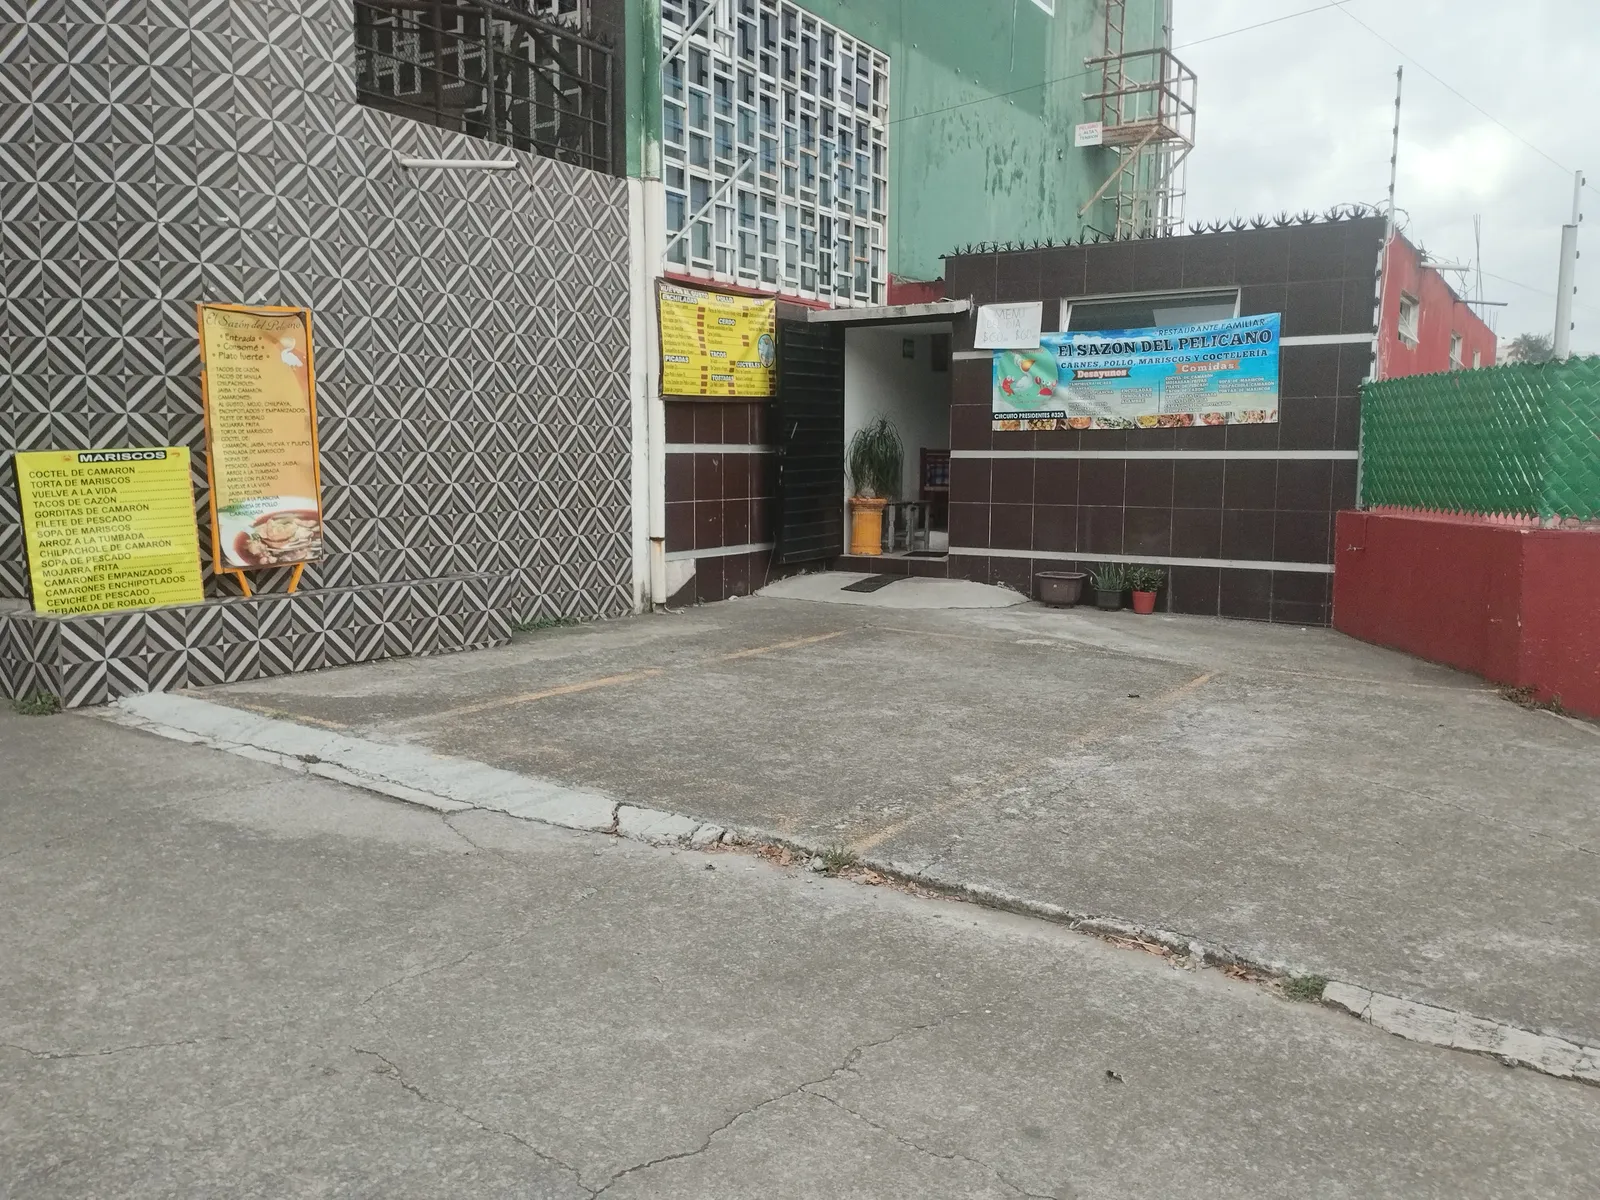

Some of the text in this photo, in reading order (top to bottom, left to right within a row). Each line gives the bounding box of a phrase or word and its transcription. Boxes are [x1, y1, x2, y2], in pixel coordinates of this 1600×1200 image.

[663, 295, 697, 304] ENCHILADAS
[251, 320, 264, 329] del
[1158, 319, 1265, 336] RESTAURANTE FAMILIAR
[225, 334, 255, 342] Entrada
[1058, 345, 1073, 357] El
[1140, 339, 1174, 353] DEL
[1178, 329, 1272, 350] PELICANO
[218, 352, 238, 360] Plato
[1061, 360, 1101, 368] CARNES,
[1104, 359, 1137, 368] POLLO,
[1139, 355, 1191, 365] MARISCOS
[1202, 349, 1268, 360] COCTELERÍA
[1077, 369, 1127, 378] Desayunos
[1181, 361, 1234, 373] Comidas
[79, 452, 166, 462] MARISCOS
[29, 470, 69, 479] COCTEL
[87, 467, 135, 476] CAMARON
[30, 477, 131, 489] TORTA DE MARISCOS
[32, 489, 69, 498] VUELVE
[80, 488, 93, 496] LA
[95, 487, 118, 495] VIDA
[33, 500, 65, 508] TACOS
[84, 496, 117, 505] CAZÓN
[35, 509, 84, 518] GORDITAS
[102, 504, 150, 514] CAMARÓN
[36, 515, 132, 528] FILETE DE PESCADO
[37, 524, 131, 538] SOPA DE MARISCOS
[39, 539, 72, 548] ARROZ
[99, 533, 145, 543] TUMBADA
[40, 545, 107, 558] CHILPACHOLE
[125, 540, 171, 550] CAMARÓN
[41, 559, 67, 568] SOPA
[86, 553, 132, 564] PESCADO
[43, 564, 119, 577] MOJARRA FRITA
[44, 568, 173, 587] CAMARONES EMPANIZADOS
[45, 576, 185, 597] CAMARONES ENCHIPOTLADOS
[47, 589, 150, 607] CEVICHE DE PESCADO
[102, 602, 114, 610] DE
[117, 597, 156, 607] ROBALO
